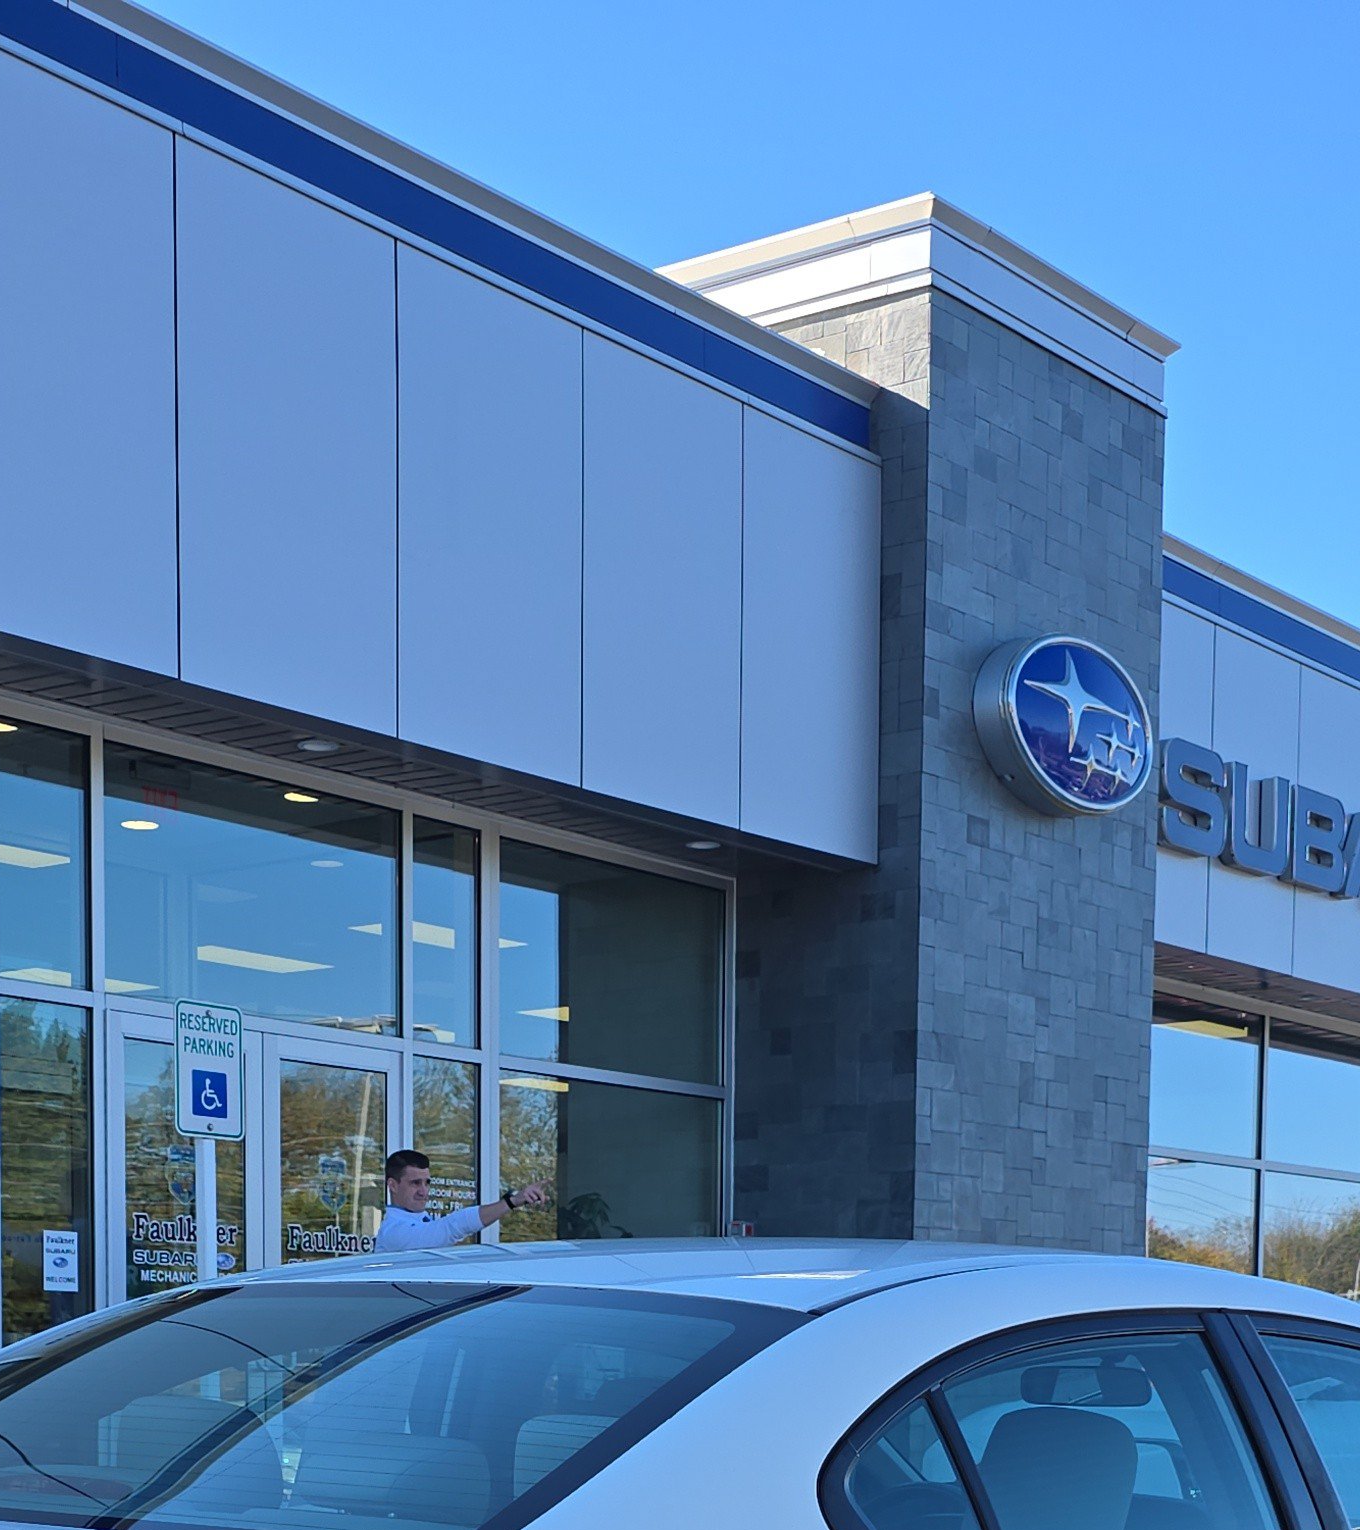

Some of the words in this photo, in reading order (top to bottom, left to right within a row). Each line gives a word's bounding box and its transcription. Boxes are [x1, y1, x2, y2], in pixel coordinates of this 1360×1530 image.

[180, 1012, 238, 1036] RESERVED
[183, 1036, 234, 1059] PARKING
[133, 1212, 238, 1246] Faulker
[132, 1249, 198, 1267] SUBAR
[45, 1276, 76, 1284] WELCOME
